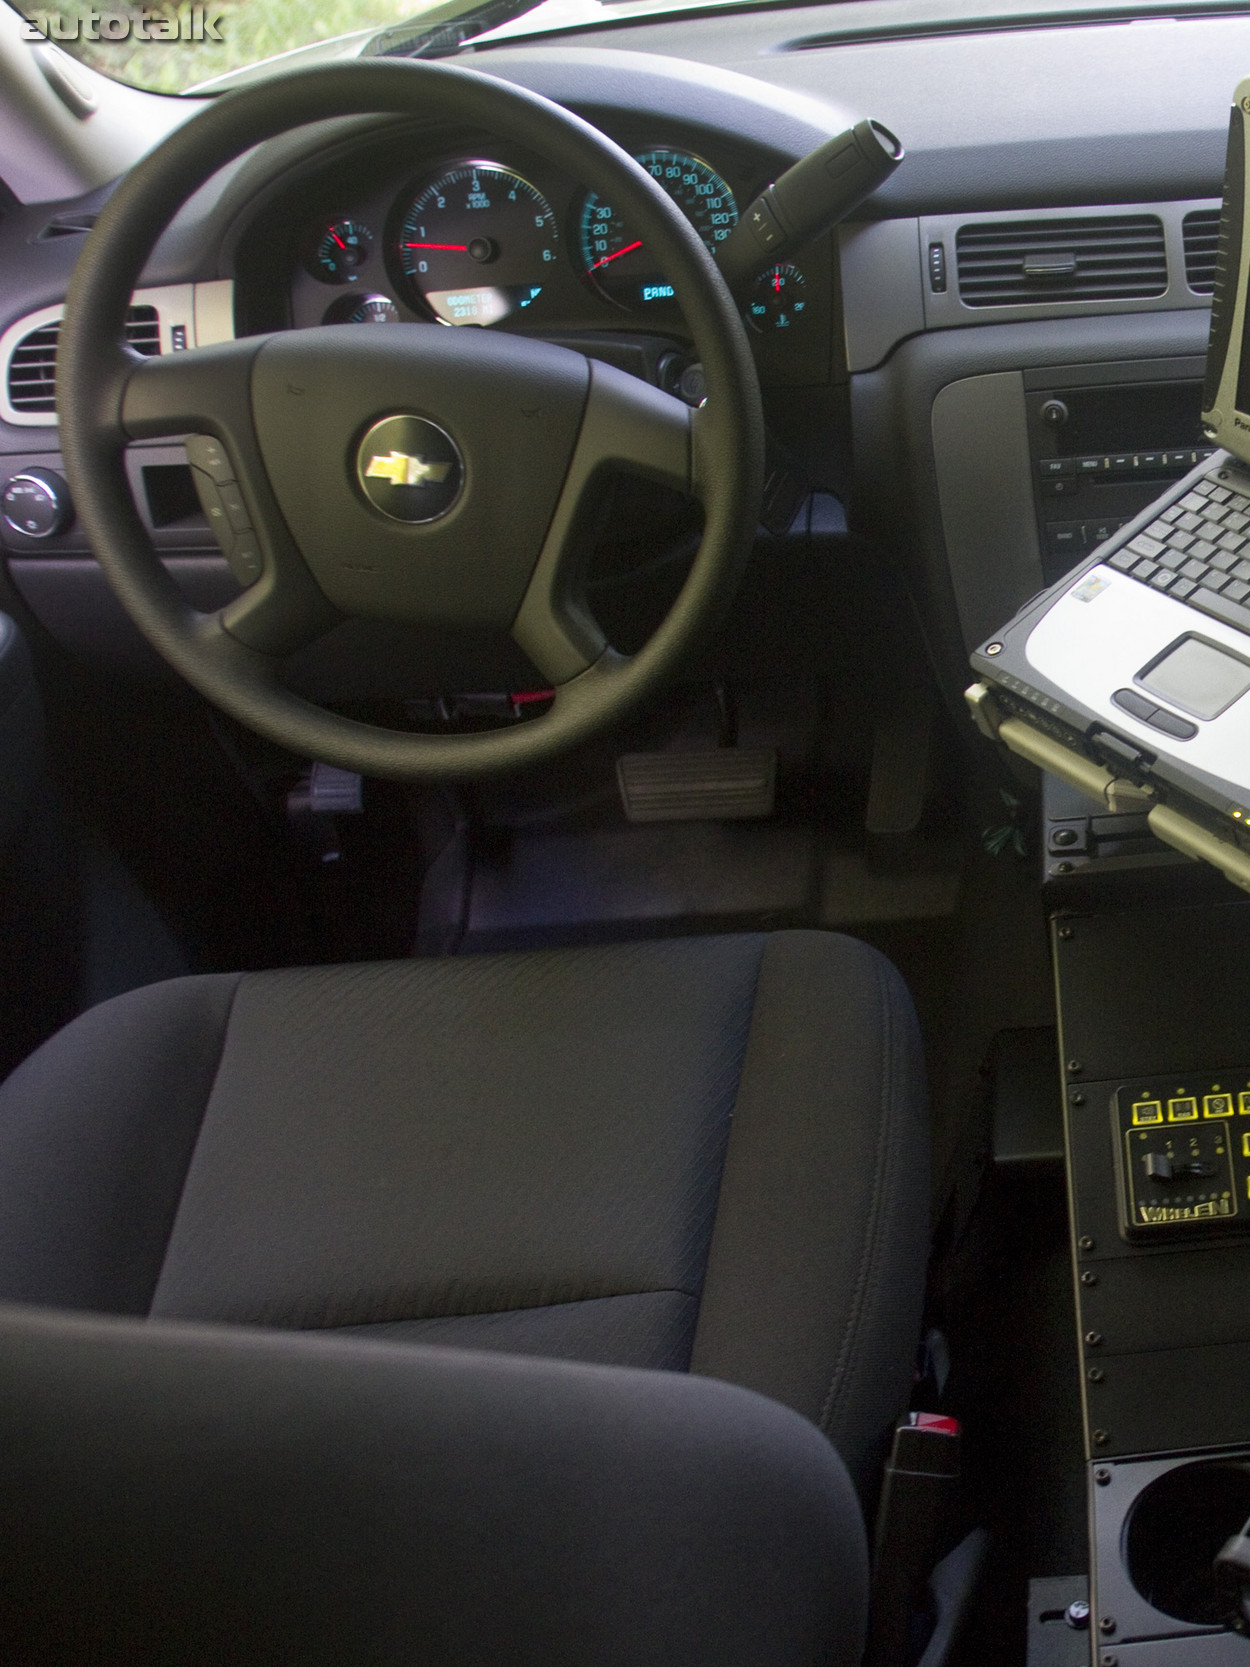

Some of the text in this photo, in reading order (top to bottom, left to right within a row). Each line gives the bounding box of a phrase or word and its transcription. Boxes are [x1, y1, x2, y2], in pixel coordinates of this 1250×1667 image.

[665, 166, 681, 178] 80
[682, 173, 698, 185] 90
[472, 180, 480, 192] 3
[695, 183, 714, 195] 100
[437, 196, 446, 208] 2
[507, 190, 516, 202] 4
[706, 197, 722, 208] 110
[596, 207, 612, 219] 30
[711, 212, 730, 225] 120
[535, 216, 544, 227] 5
[592, 223, 608, 235] 20
[594, 239, 607, 251] 10
[542, 250, 551, 262] 6
[418, 261, 428, 273] 0
[643, 286, 675, 300] PRND
